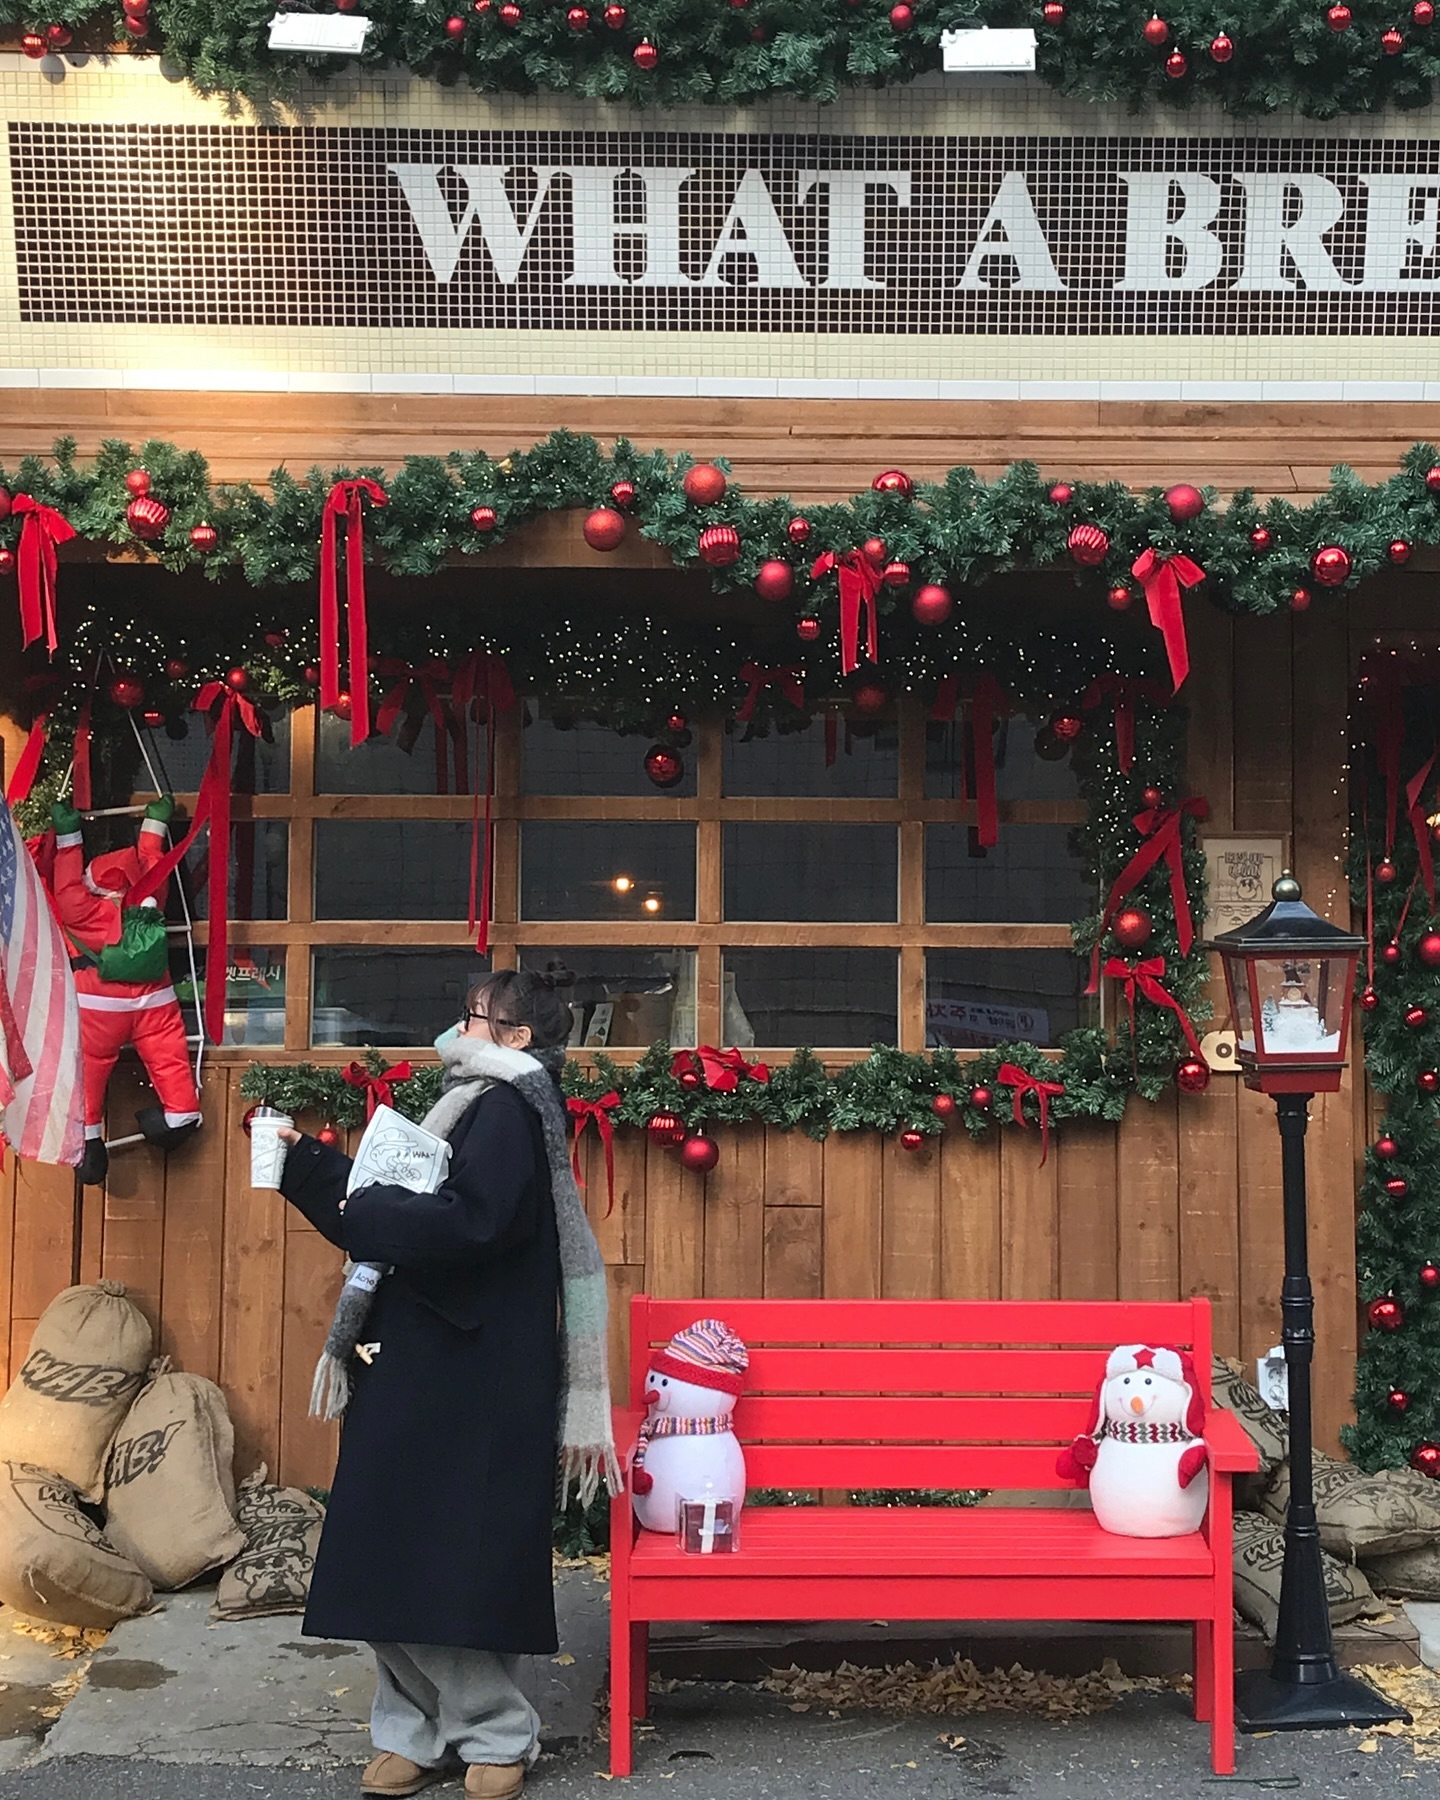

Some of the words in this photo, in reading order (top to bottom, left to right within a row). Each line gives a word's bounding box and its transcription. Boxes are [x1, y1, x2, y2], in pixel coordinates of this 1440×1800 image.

[386, 162, 912, 289] WHAT
[955, 169, 1067, 290] A
[1115, 171, 1440, 292] BRE
[105, 1420, 187, 1489] AB!
